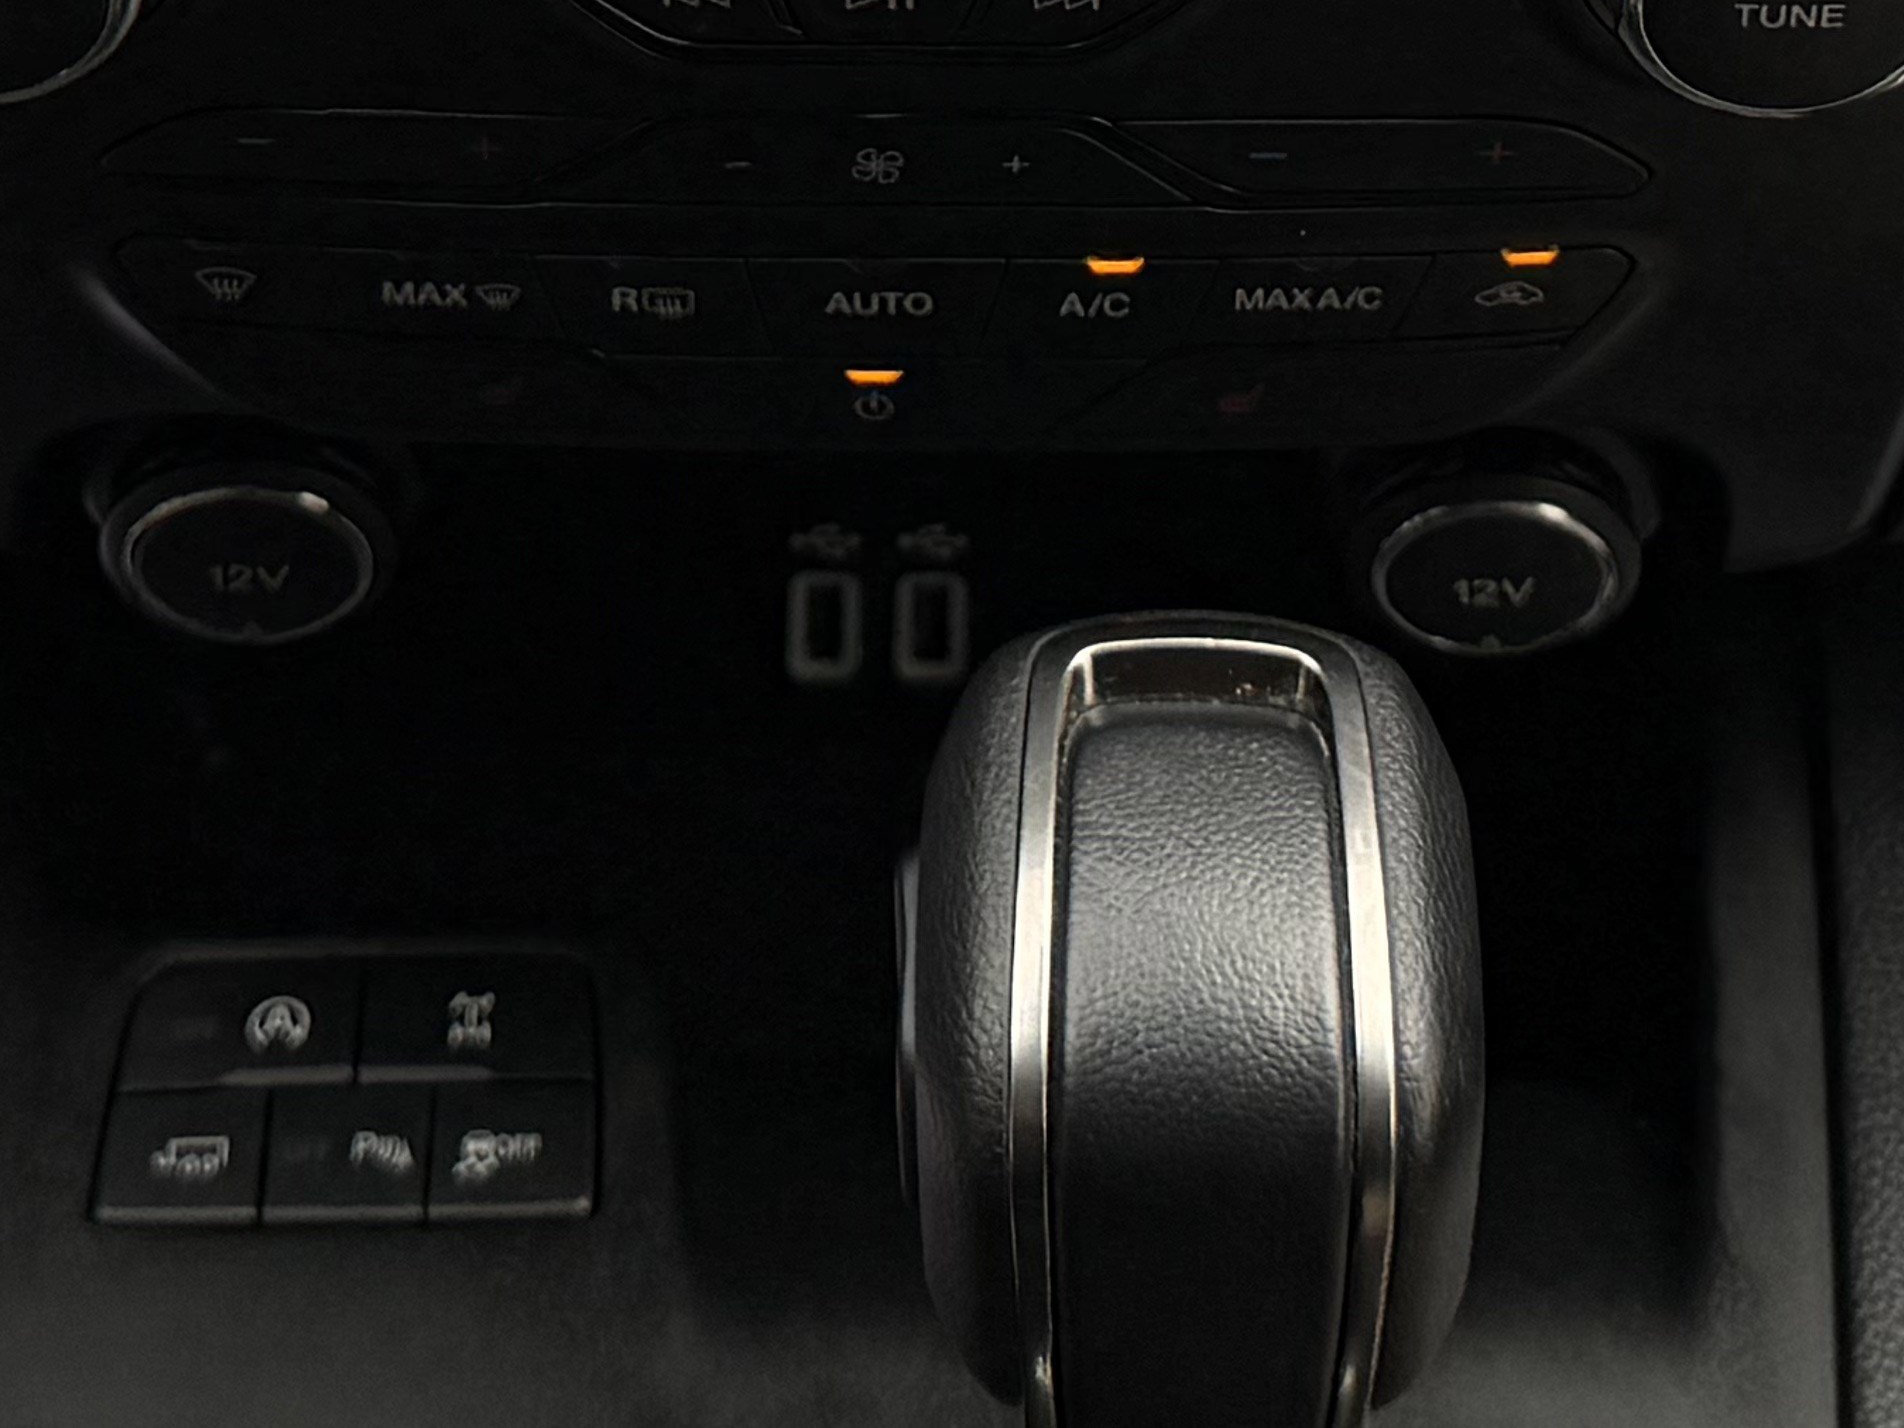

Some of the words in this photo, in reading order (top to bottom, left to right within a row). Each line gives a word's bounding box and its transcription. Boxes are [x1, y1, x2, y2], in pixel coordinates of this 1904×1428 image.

[1734, 3, 1847, 29] TUNE
[382, 280, 468, 308] MAX
[824, 291, 934, 316] AUTO
[1059, 291, 1131, 318] A/C
[208, 562, 291, 593] 12V
[1452, 575, 1535, 608] 12V
